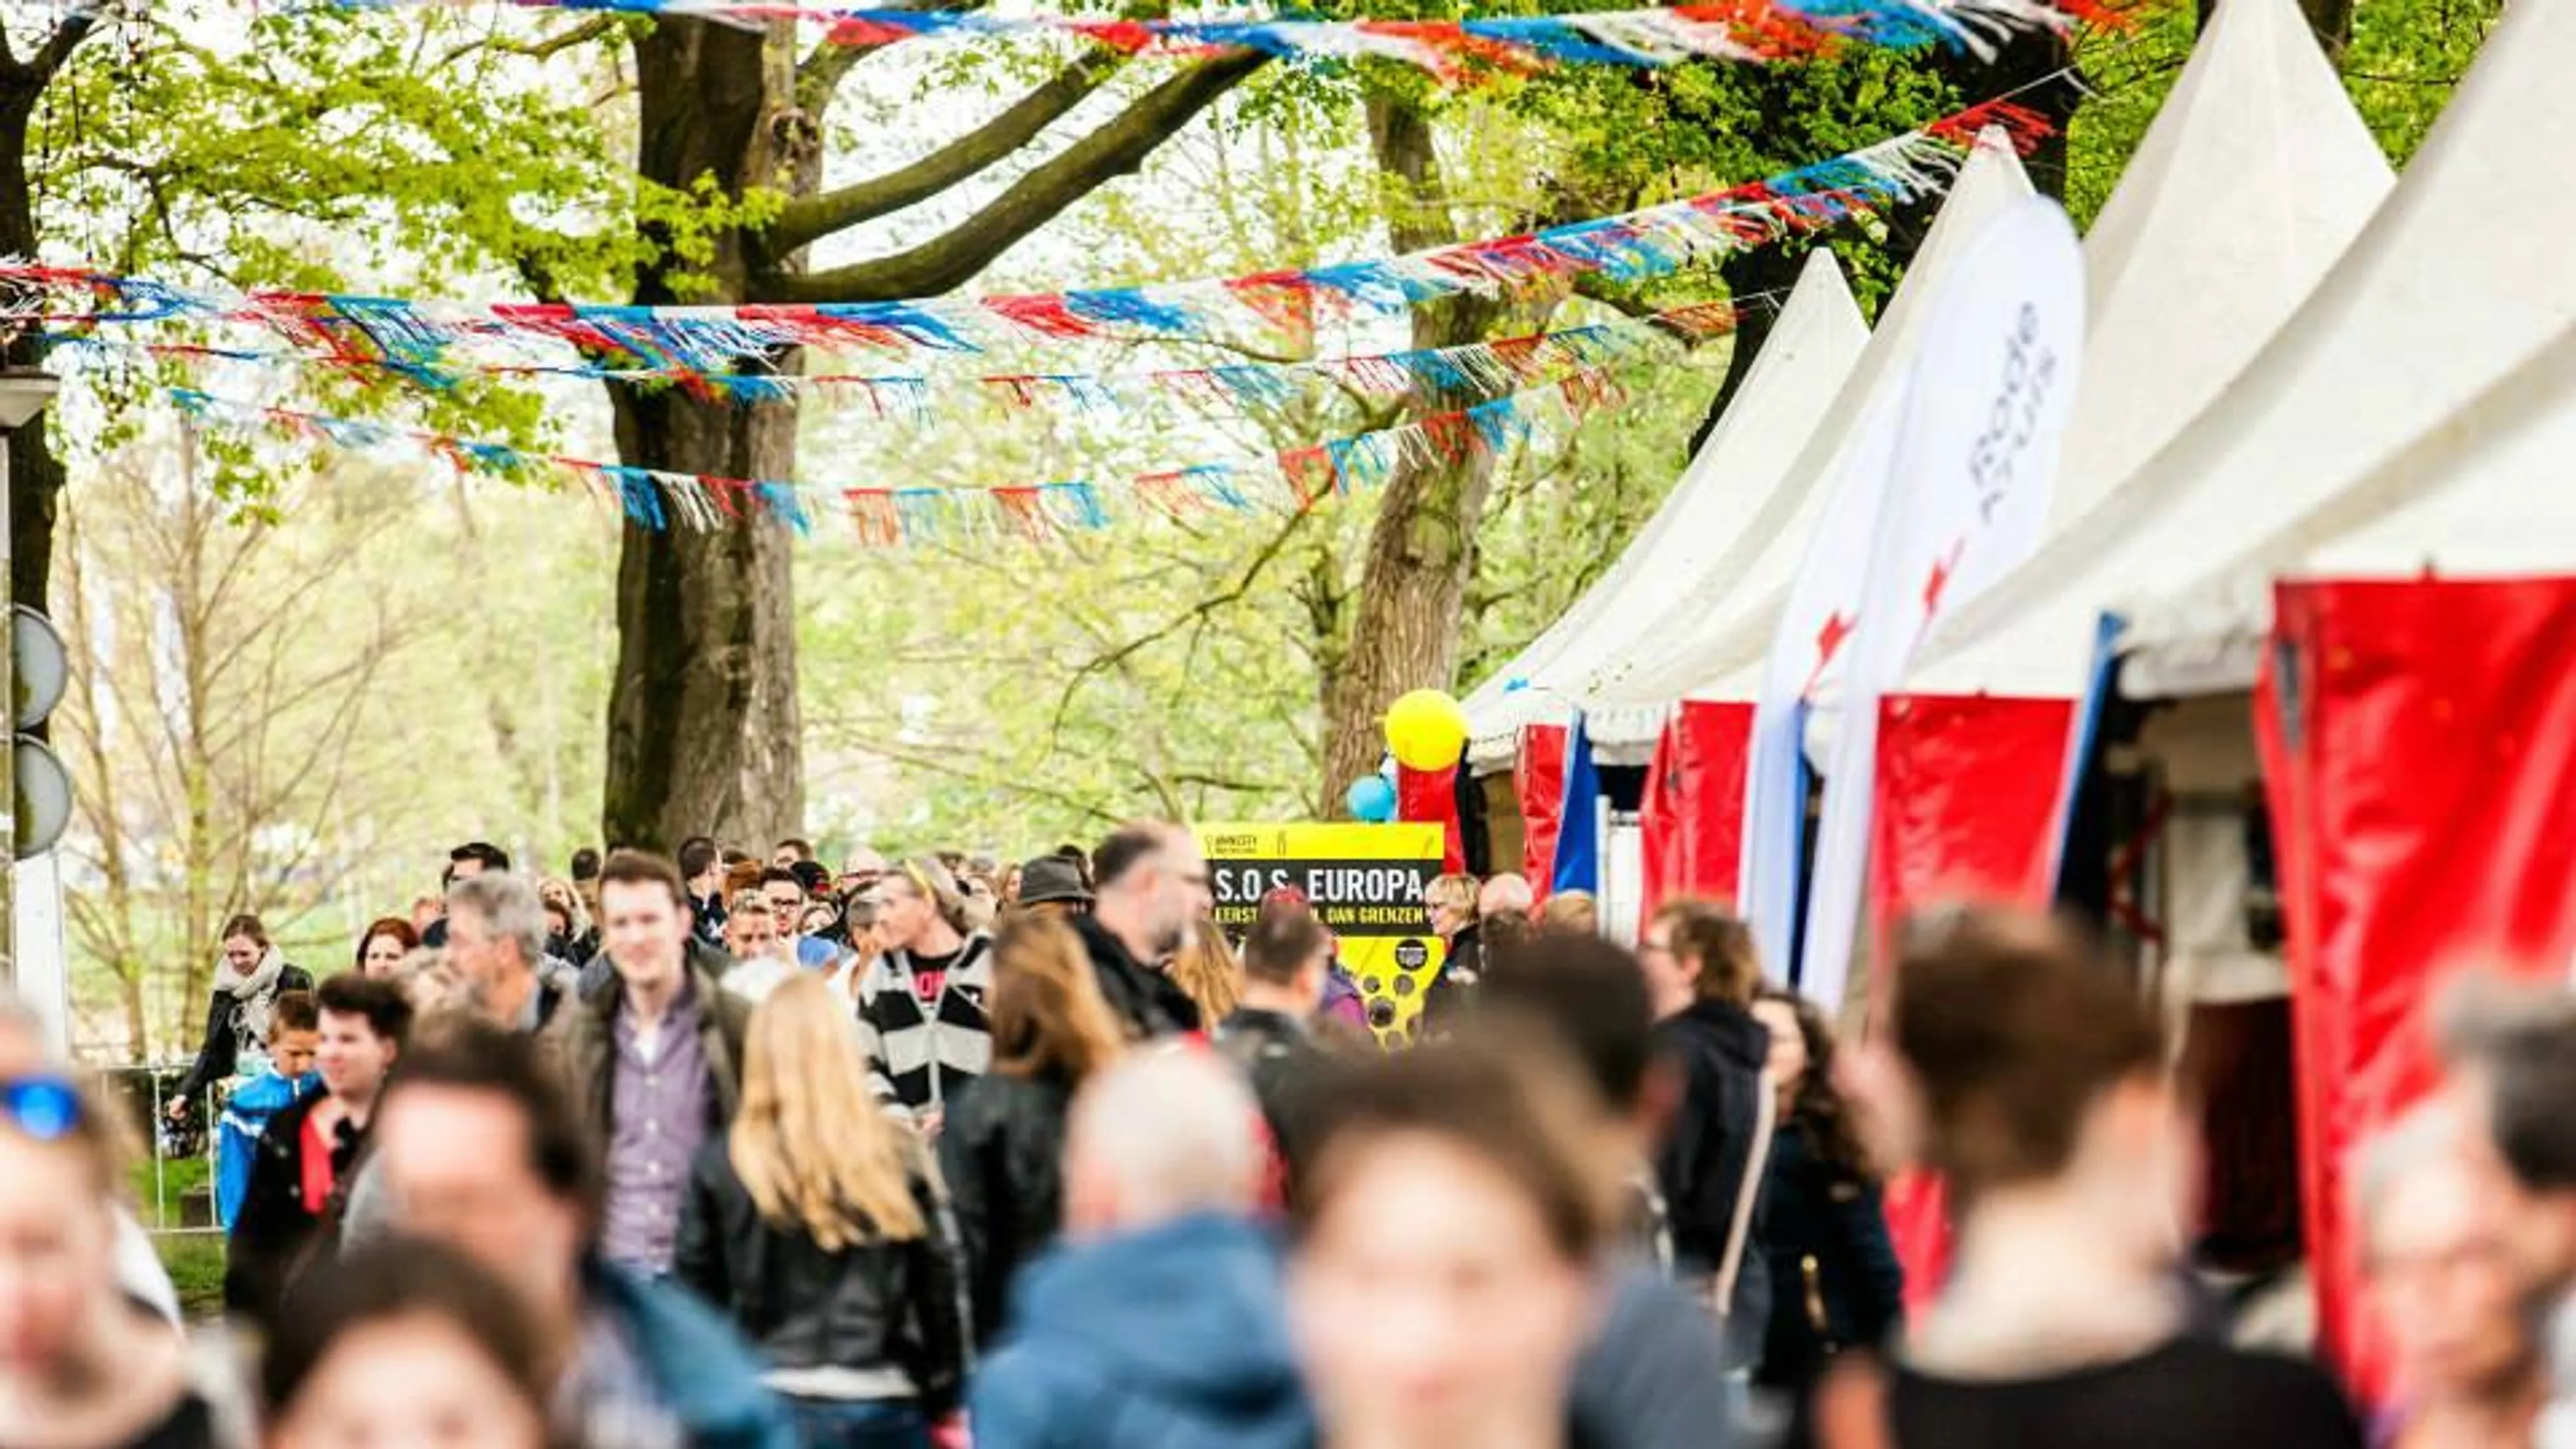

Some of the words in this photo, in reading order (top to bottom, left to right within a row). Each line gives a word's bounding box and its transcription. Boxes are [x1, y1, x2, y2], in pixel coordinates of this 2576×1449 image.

[1968, 302, 2039, 488] Rode
[1216, 869, 1289, 901] S.OS
[1308, 869, 1423, 901] EUROPA
[1216, 907, 1257, 923] EERST
[1328, 907, 1356, 923] DAN
[1360, 907, 1423, 923] GRENZEN
